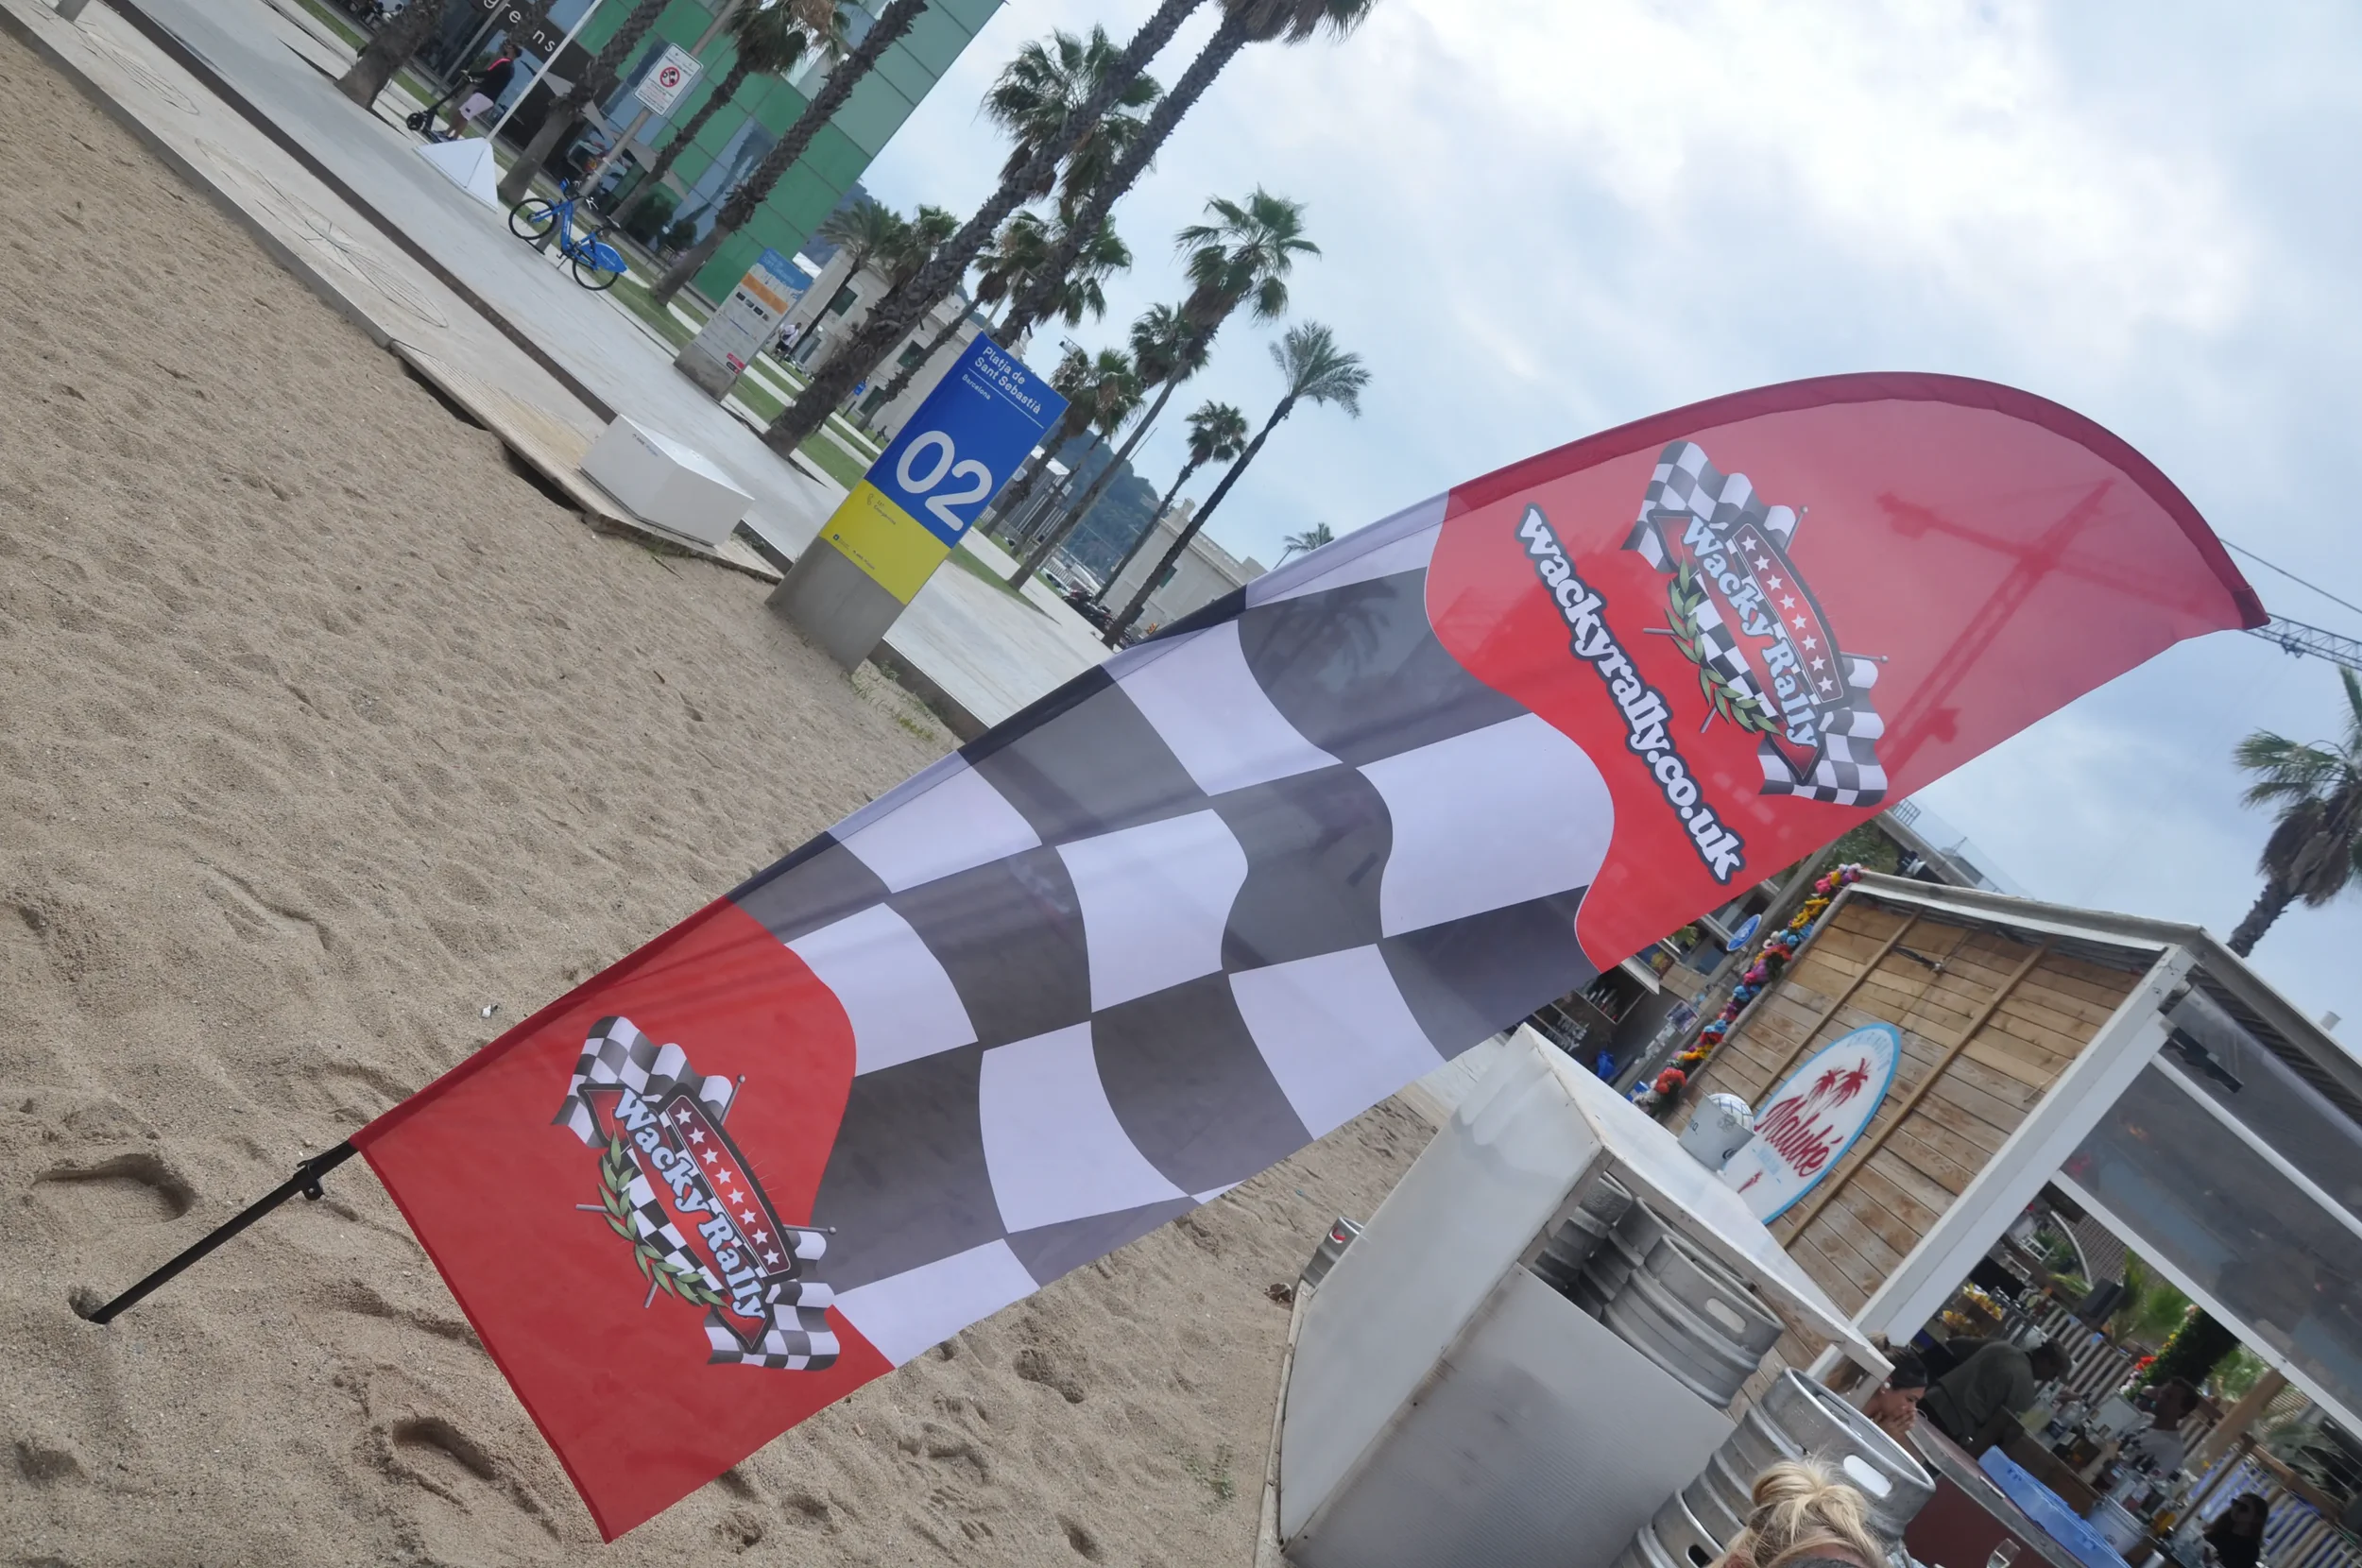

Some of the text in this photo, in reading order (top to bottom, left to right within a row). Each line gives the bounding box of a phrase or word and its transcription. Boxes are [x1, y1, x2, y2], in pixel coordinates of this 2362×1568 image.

[962, 374, 991, 401] Barcelona
[974, 356, 1041, 415] Sant Sebastià
[982, 346, 1025, 384] Platja de
[896, 430, 992, 532] 02
[1682, 515, 1820, 748] Wacky Rally
[1517, 505, 1745, 883] wackyrally.co.uk
[614, 1088, 767, 1320] Wacky Rally
